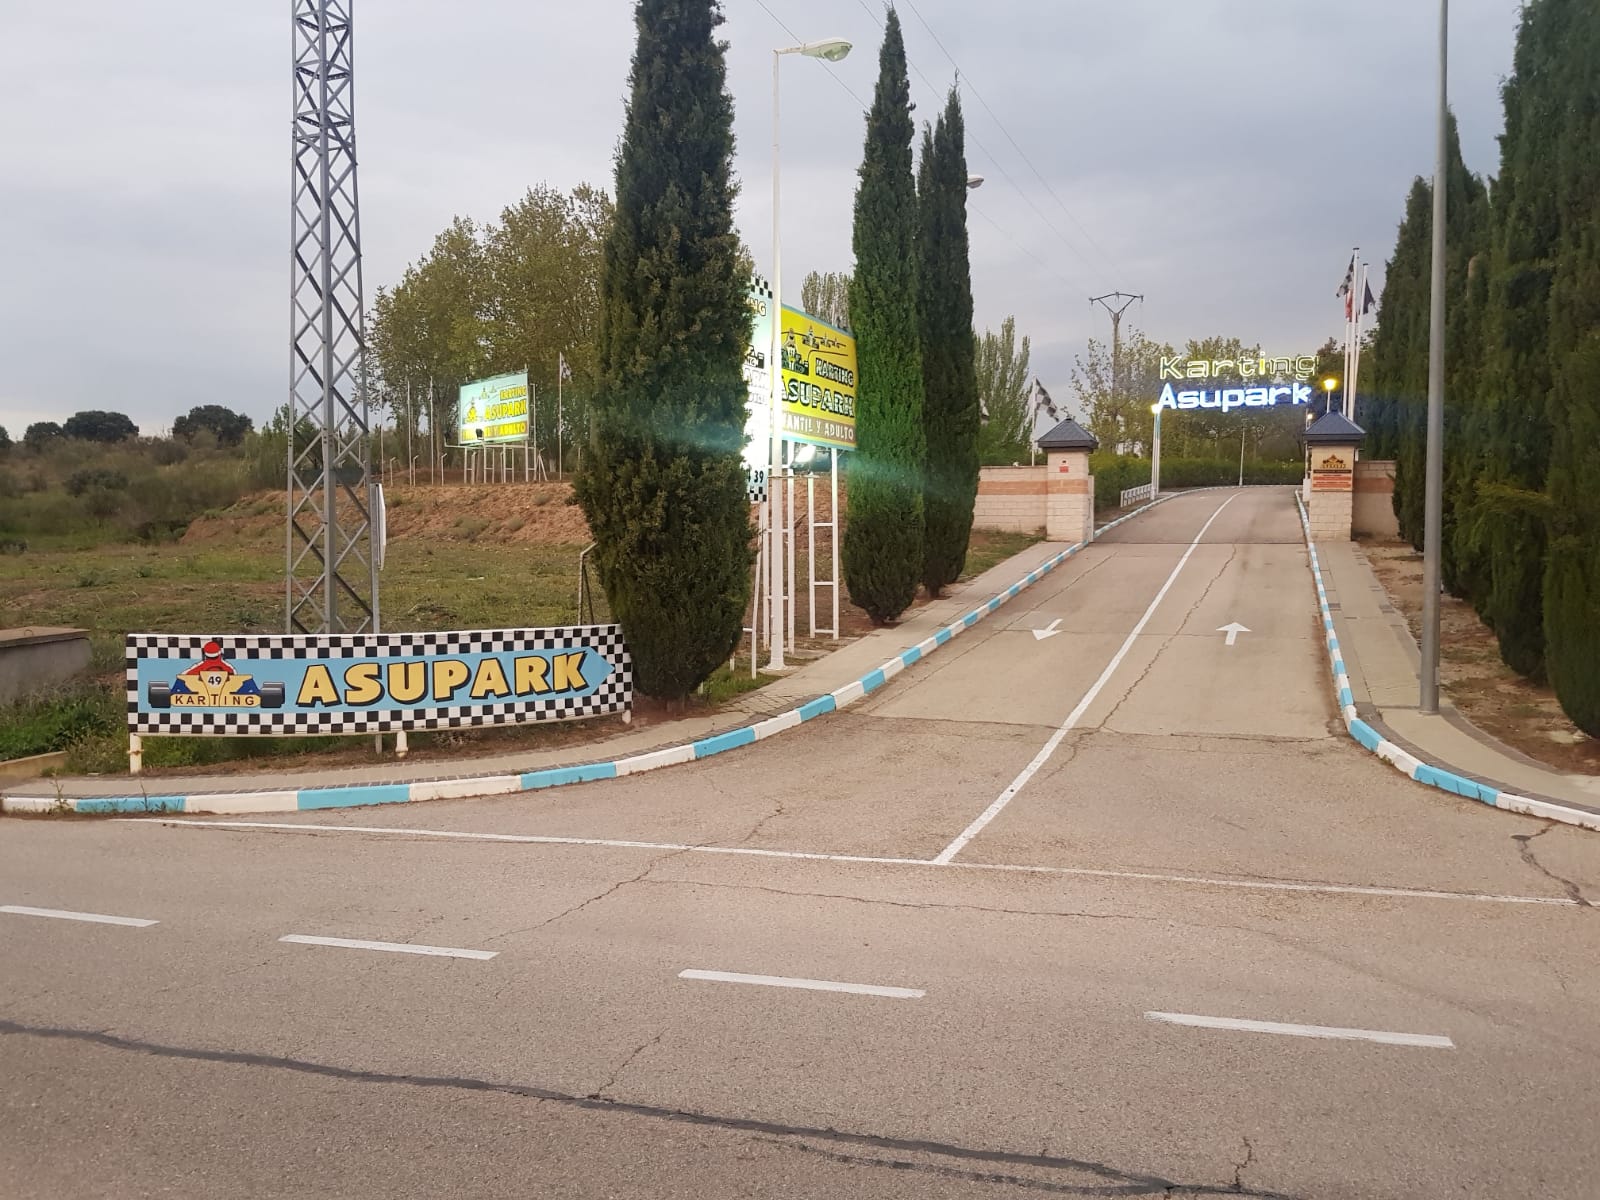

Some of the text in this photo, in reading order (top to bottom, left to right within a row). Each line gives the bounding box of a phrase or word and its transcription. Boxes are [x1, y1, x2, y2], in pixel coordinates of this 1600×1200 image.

[815, 357, 854, 388] KARTING
[1159, 351, 1319, 380] Karting
[1158, 382, 1312, 413] Asupark
[485, 399, 527, 421] ASUPARK
[824, 422, 854, 440] ADULTO
[753, 470, 764, 483] 39
[207, 675, 222, 686] 49
[296, 650, 590, 708] ASUPARK
[175, 693, 255, 706] KARTING
